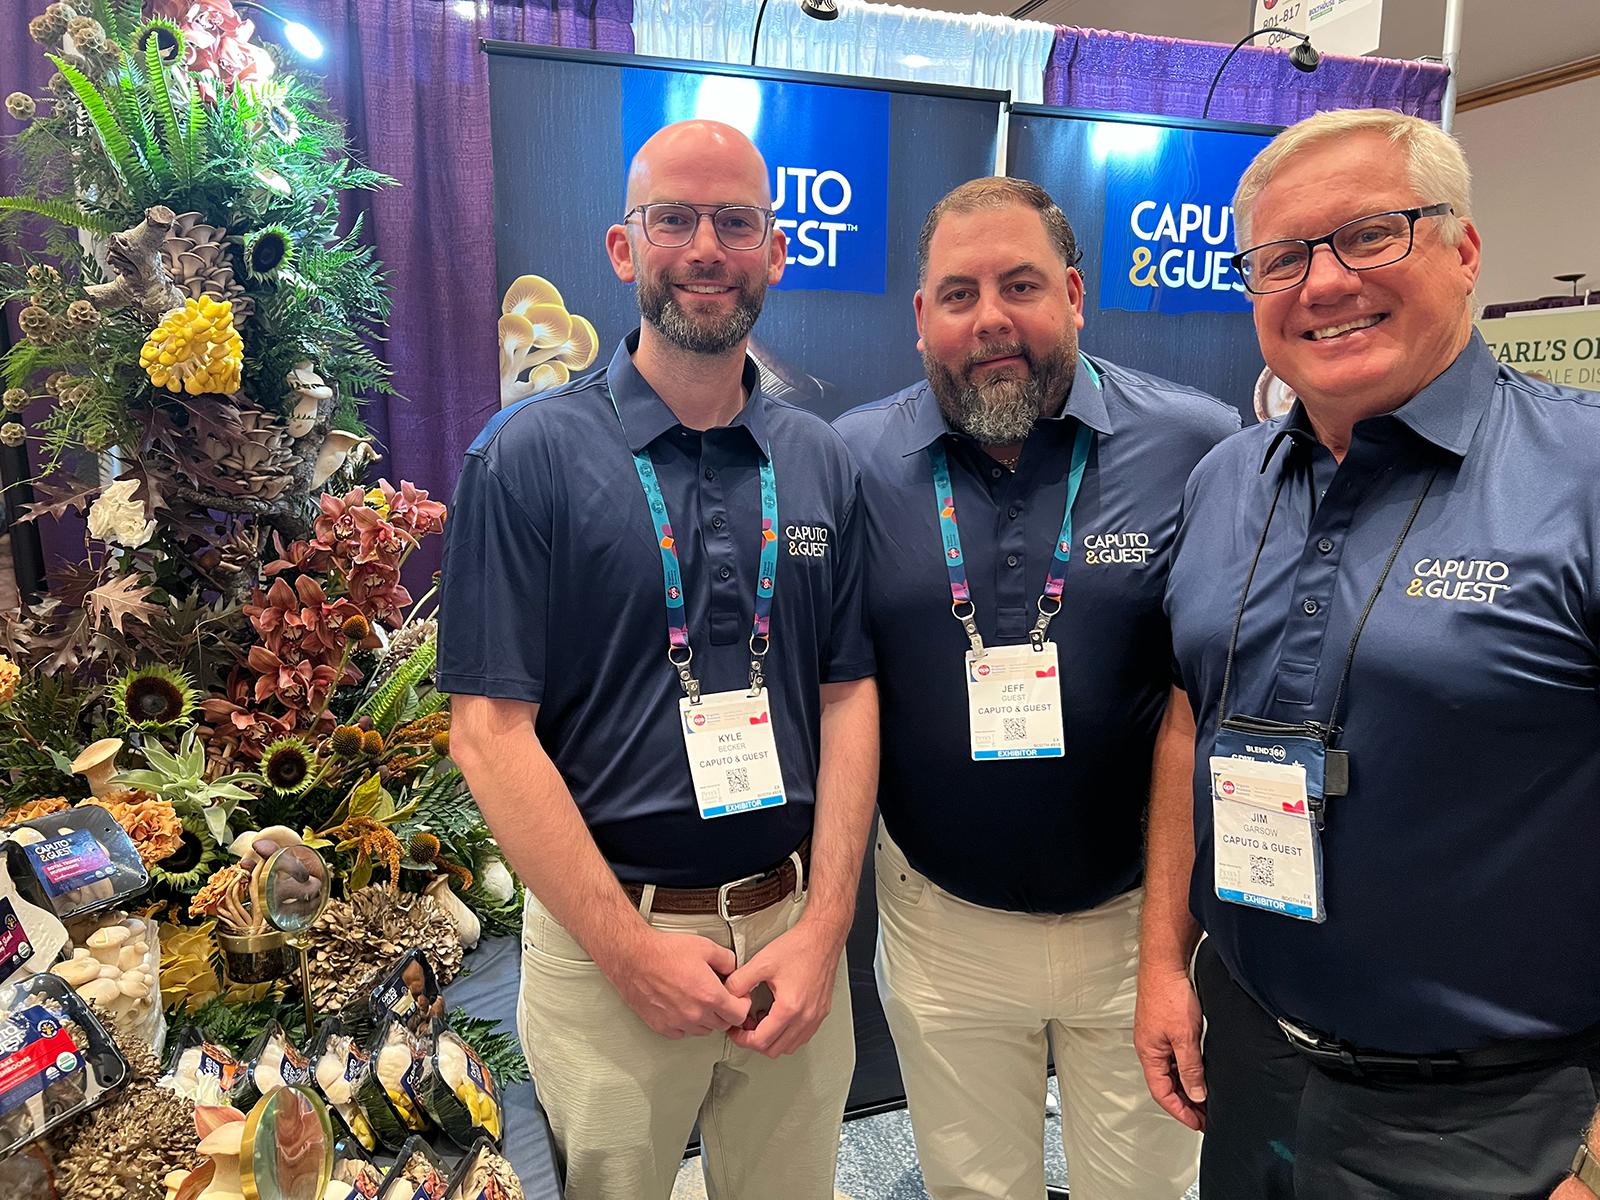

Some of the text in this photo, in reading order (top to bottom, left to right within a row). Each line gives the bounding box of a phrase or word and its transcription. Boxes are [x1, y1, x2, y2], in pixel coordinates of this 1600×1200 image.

[1263, 3, 1301, 29] 801-817
[1130, 200, 1235, 245] CAPU
[785, 525, 828, 542] CAPUTO
[1083, 532, 1149, 549] CAPUTO
[1414, 558, 1510, 582] CAPUTO
[1001, 684, 1025, 693] JEFF
[1001, 694, 1026, 702] GUEST
[977, 705, 1013, 715] CAPUTO
[1022, 703, 1052, 712] GUEST
[718, 732, 743, 743] KYLE
[718, 742, 746, 753] BECKER
[997, 749, 1038, 758] EXHIBITOR
[1245, 745, 1286, 758] BLEND360
[699, 751, 769, 769] CAPUTO & GUEST
[725, 799, 763, 813] EXHIBITOR
[1251, 812, 1268, 824] JIM
[1243, 824, 1278, 837] GARSOW
[35, 840, 69, 855] CAPUTO
[1222, 834, 1303, 857] CAPUTO & GUEST
[46, 863, 63, 871] ROYAL
[50, 864, 80, 875] MUSHROOMS
[1243, 893, 1286, 910] EXHIBITOR
